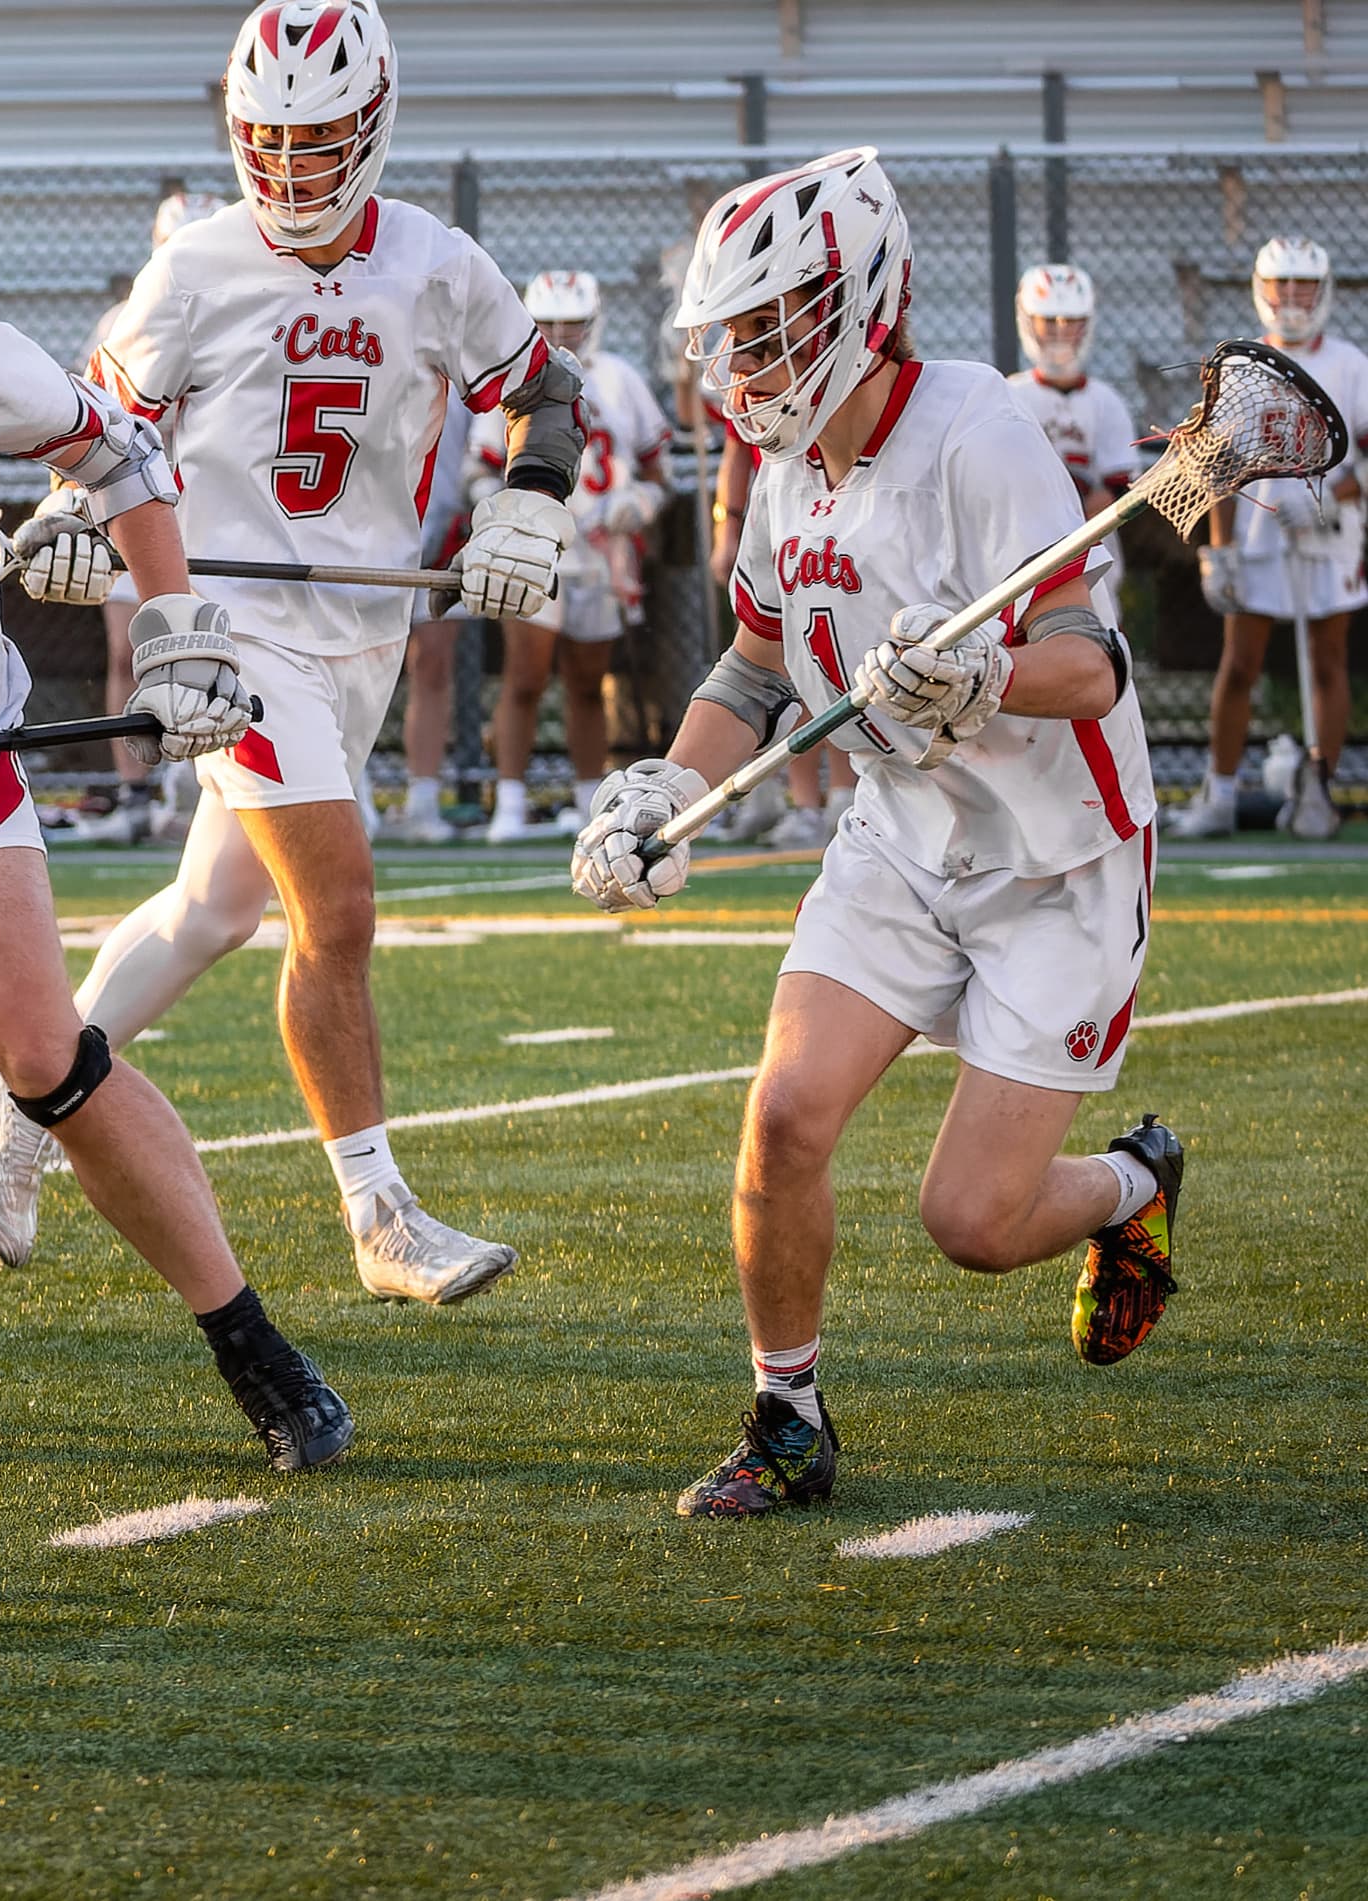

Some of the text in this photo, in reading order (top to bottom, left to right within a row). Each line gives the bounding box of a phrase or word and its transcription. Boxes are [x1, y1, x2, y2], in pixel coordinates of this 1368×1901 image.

[272, 313, 384, 367] 'Cats
[270, 374, 370, 520] 5
[803, 607, 896, 755] 1
